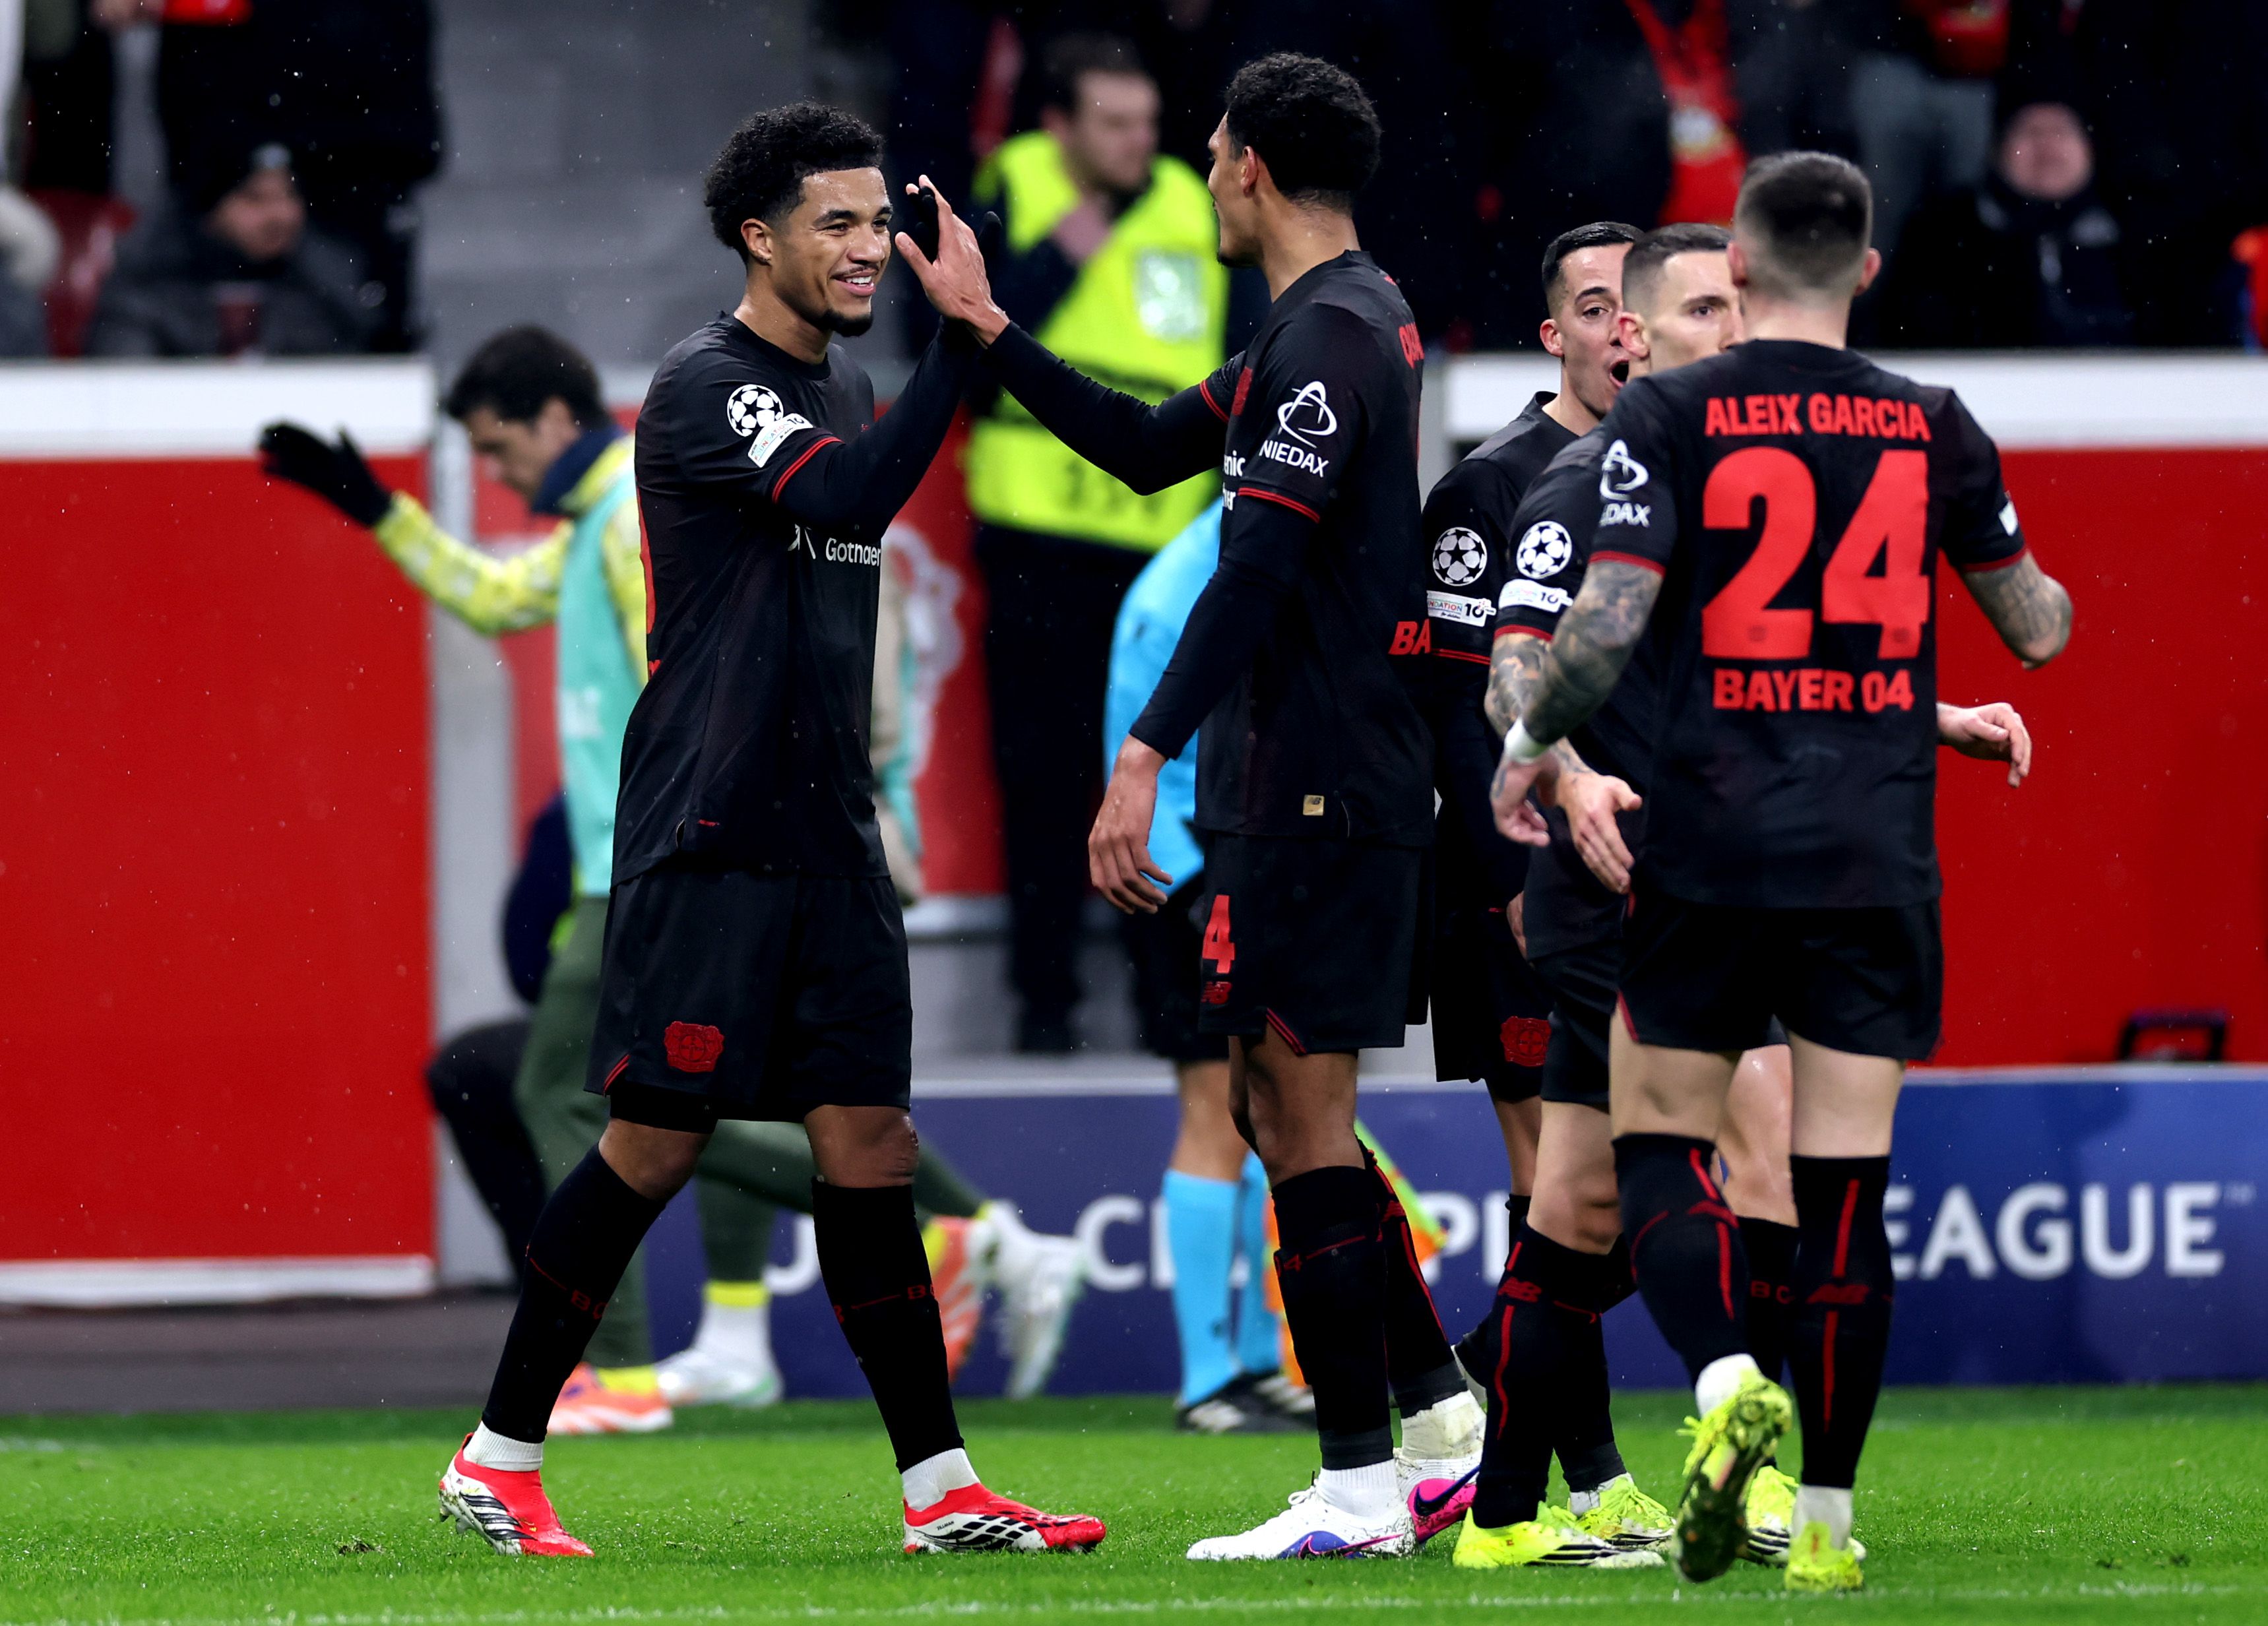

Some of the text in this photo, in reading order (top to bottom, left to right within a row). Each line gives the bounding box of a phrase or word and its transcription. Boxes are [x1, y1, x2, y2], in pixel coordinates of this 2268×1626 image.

[1705, 392, 1932, 442] ALEIX GARCIA
[1259, 439, 1329, 478] NIEDAX
[1701, 446, 1930, 660] 24
[1713, 668, 1914, 712] BAYER 04
[1202, 894, 1236, 974] 4
[1883, 1183, 2225, 1280] EAGUE
